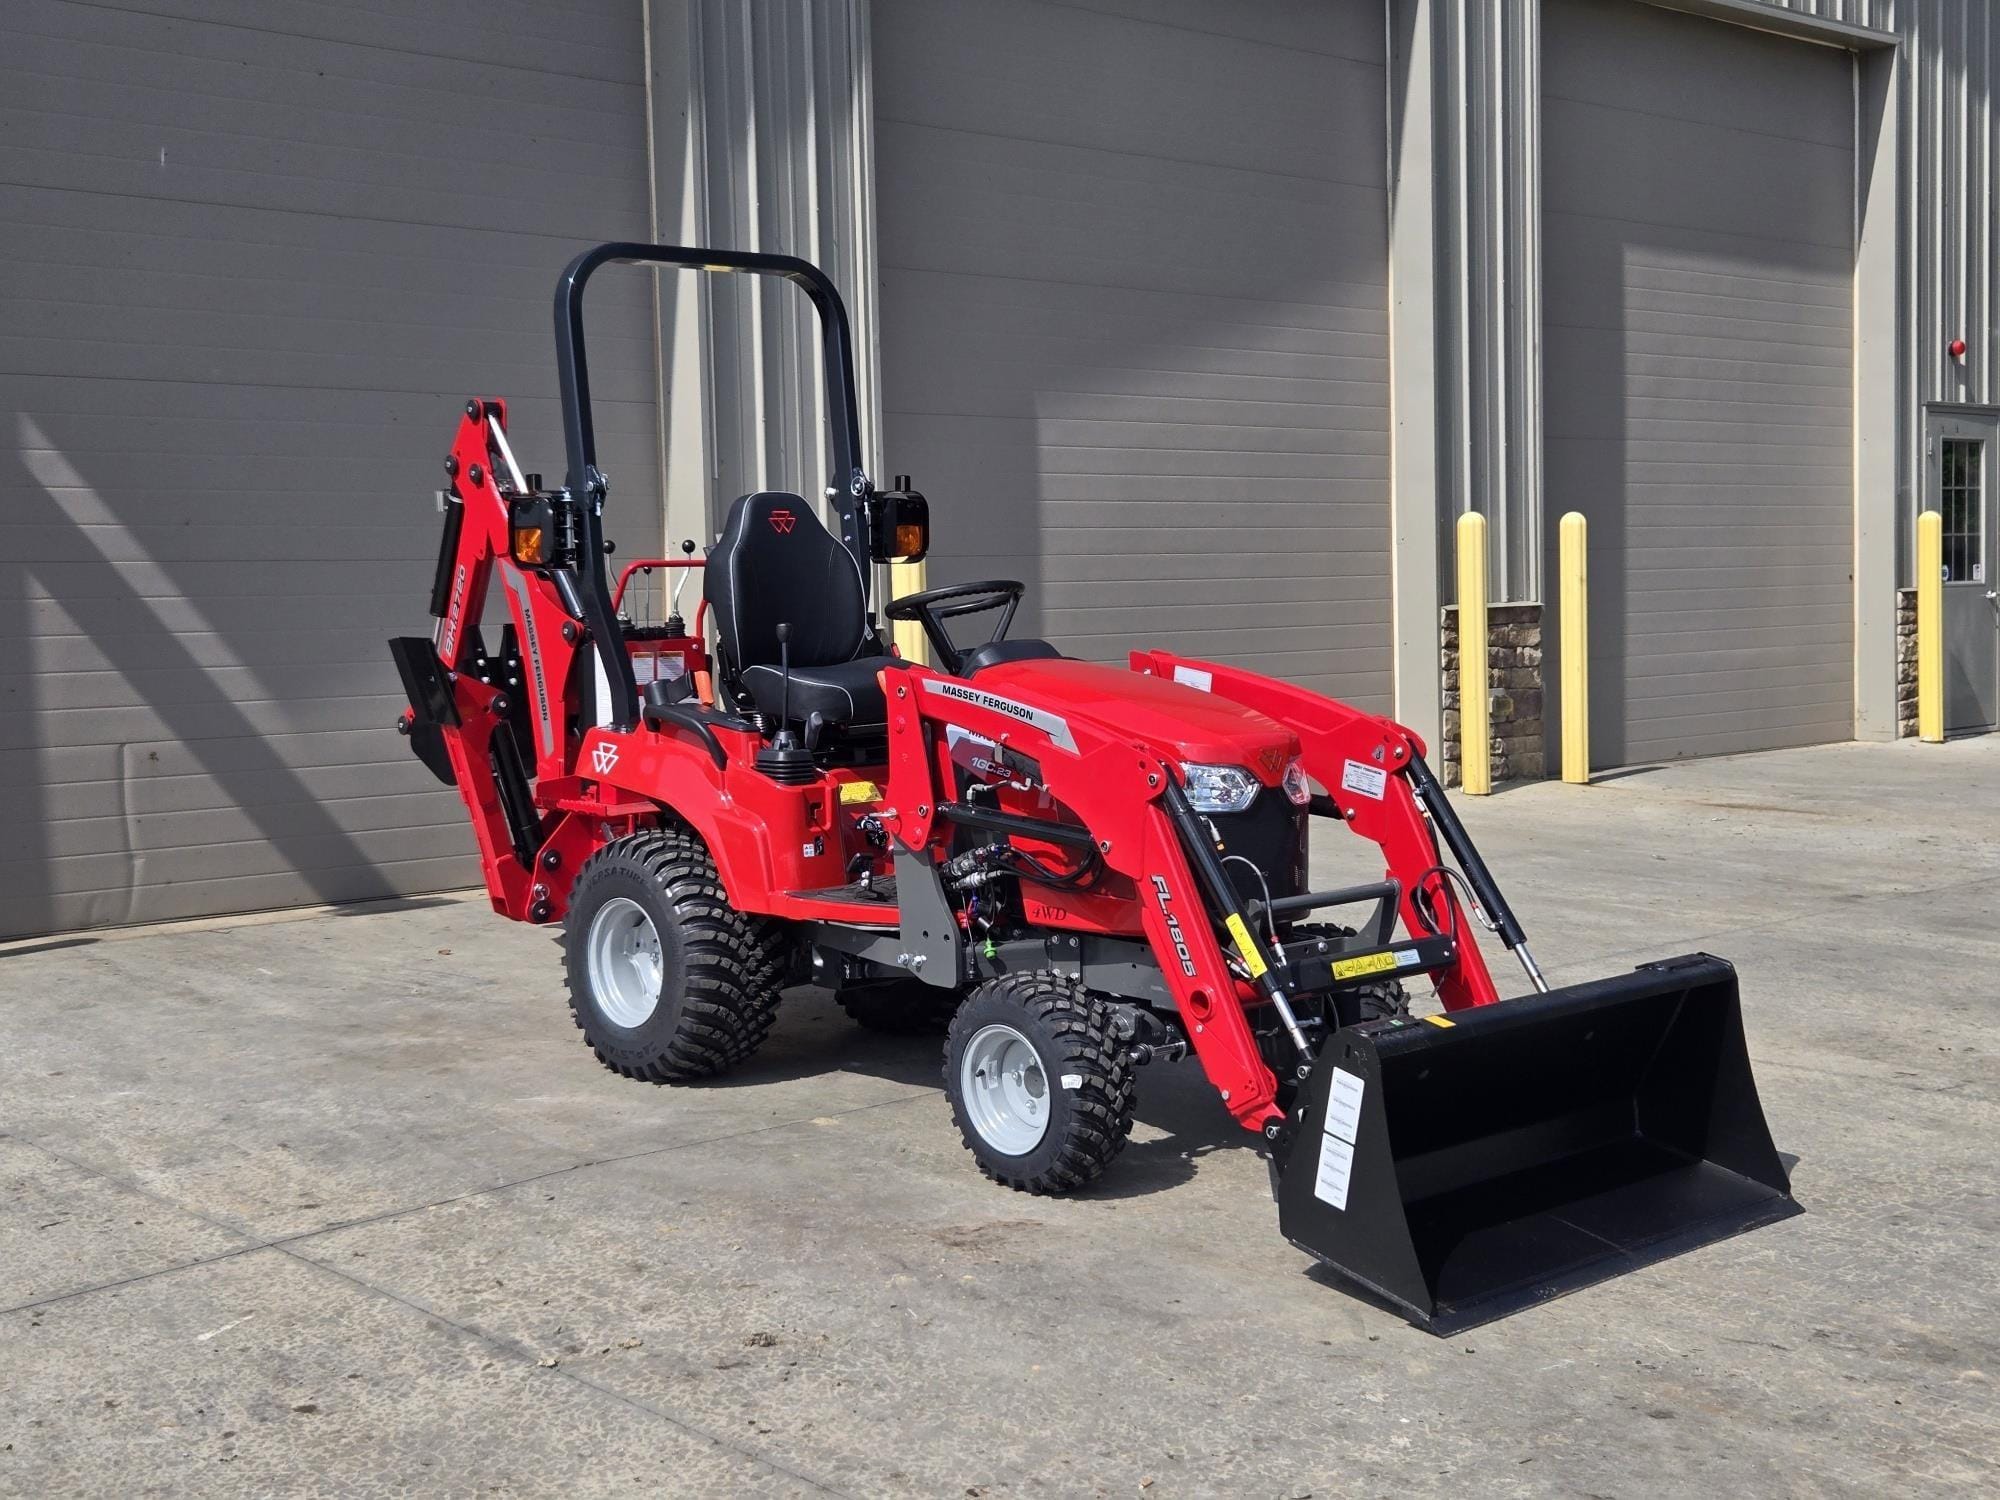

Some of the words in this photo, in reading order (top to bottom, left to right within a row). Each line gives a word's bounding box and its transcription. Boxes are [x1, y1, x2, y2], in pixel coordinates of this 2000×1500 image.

[525, 608, 538, 655] MASSEY
[534, 659, 548, 721] FERGUSON
[942, 685, 980, 702] MASSEY
[983, 696, 1034, 721] FERGUSON
[971, 757, 1011, 777] 1GC.23
[1032, 905, 1067, 921] 4WD
[1150, 875, 1197, 977] FL.1805
